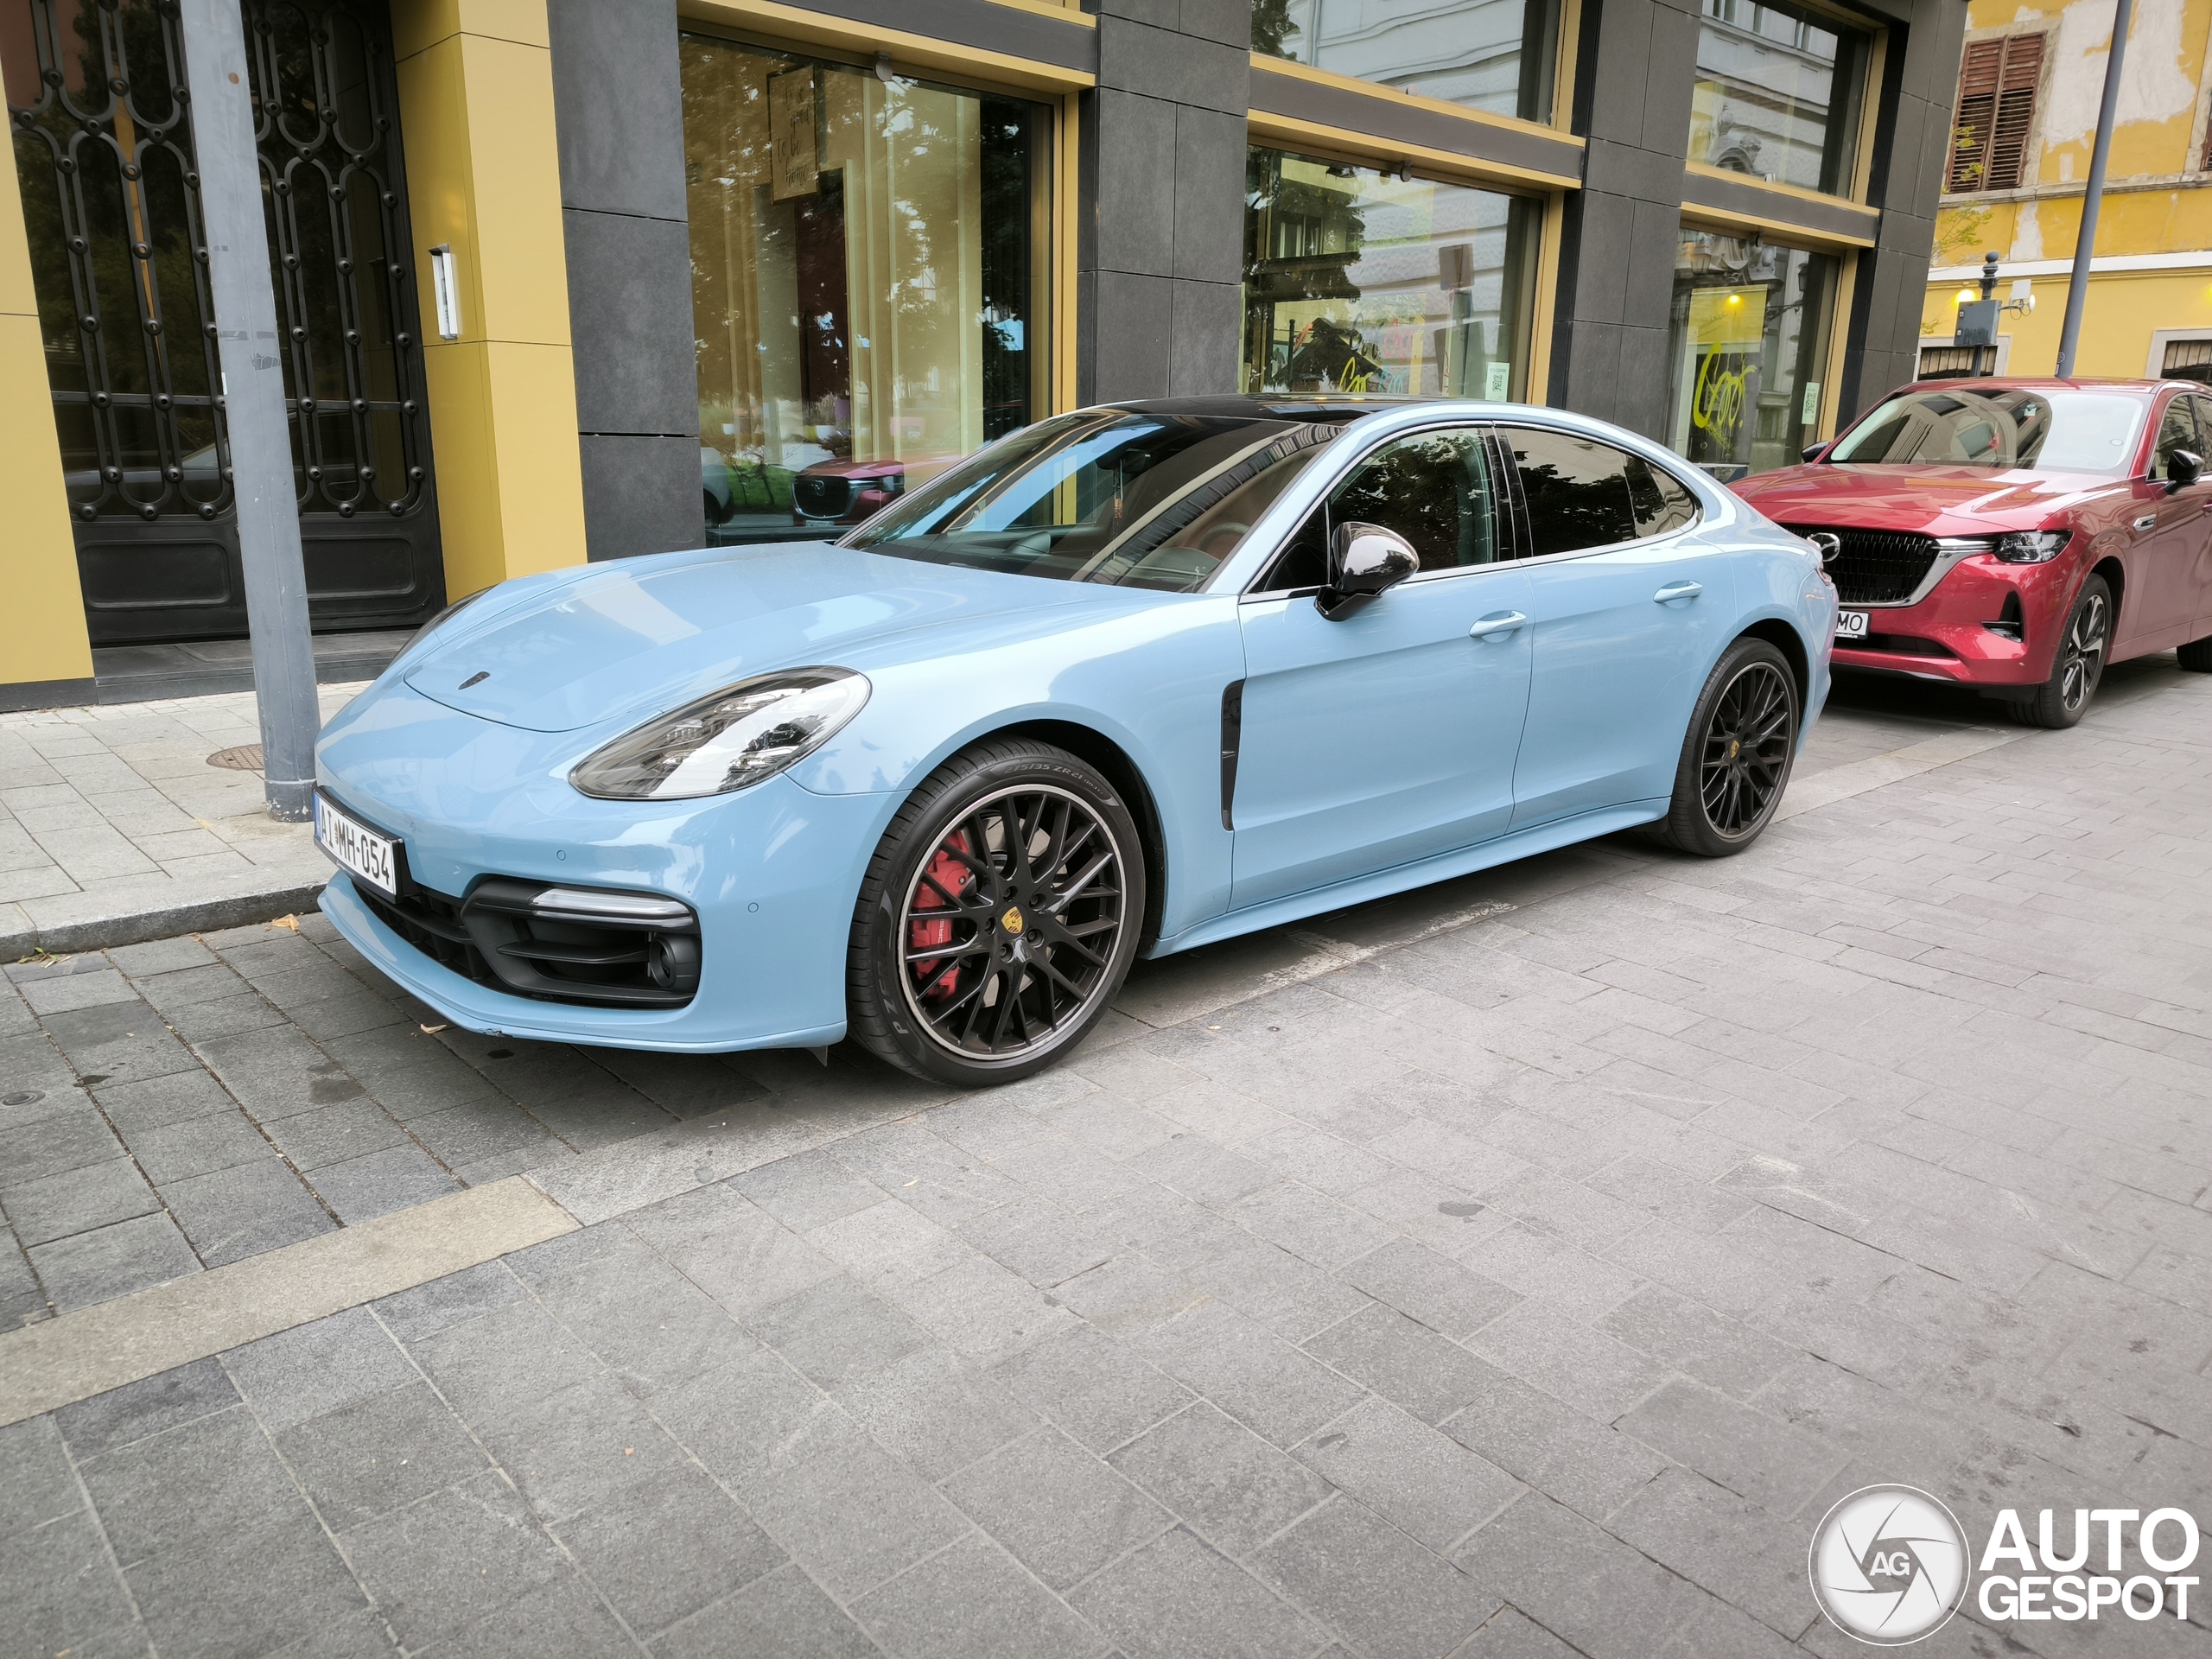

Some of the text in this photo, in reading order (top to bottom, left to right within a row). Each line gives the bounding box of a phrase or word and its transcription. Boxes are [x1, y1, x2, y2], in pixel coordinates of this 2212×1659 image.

[776, 134, 803, 163] to be
[1837, 613, 1863, 632] MO
[1005, 763, 1051, 774] 275/35
[321, 804, 334, 849] AI
[893, 1021, 909, 1034] P
